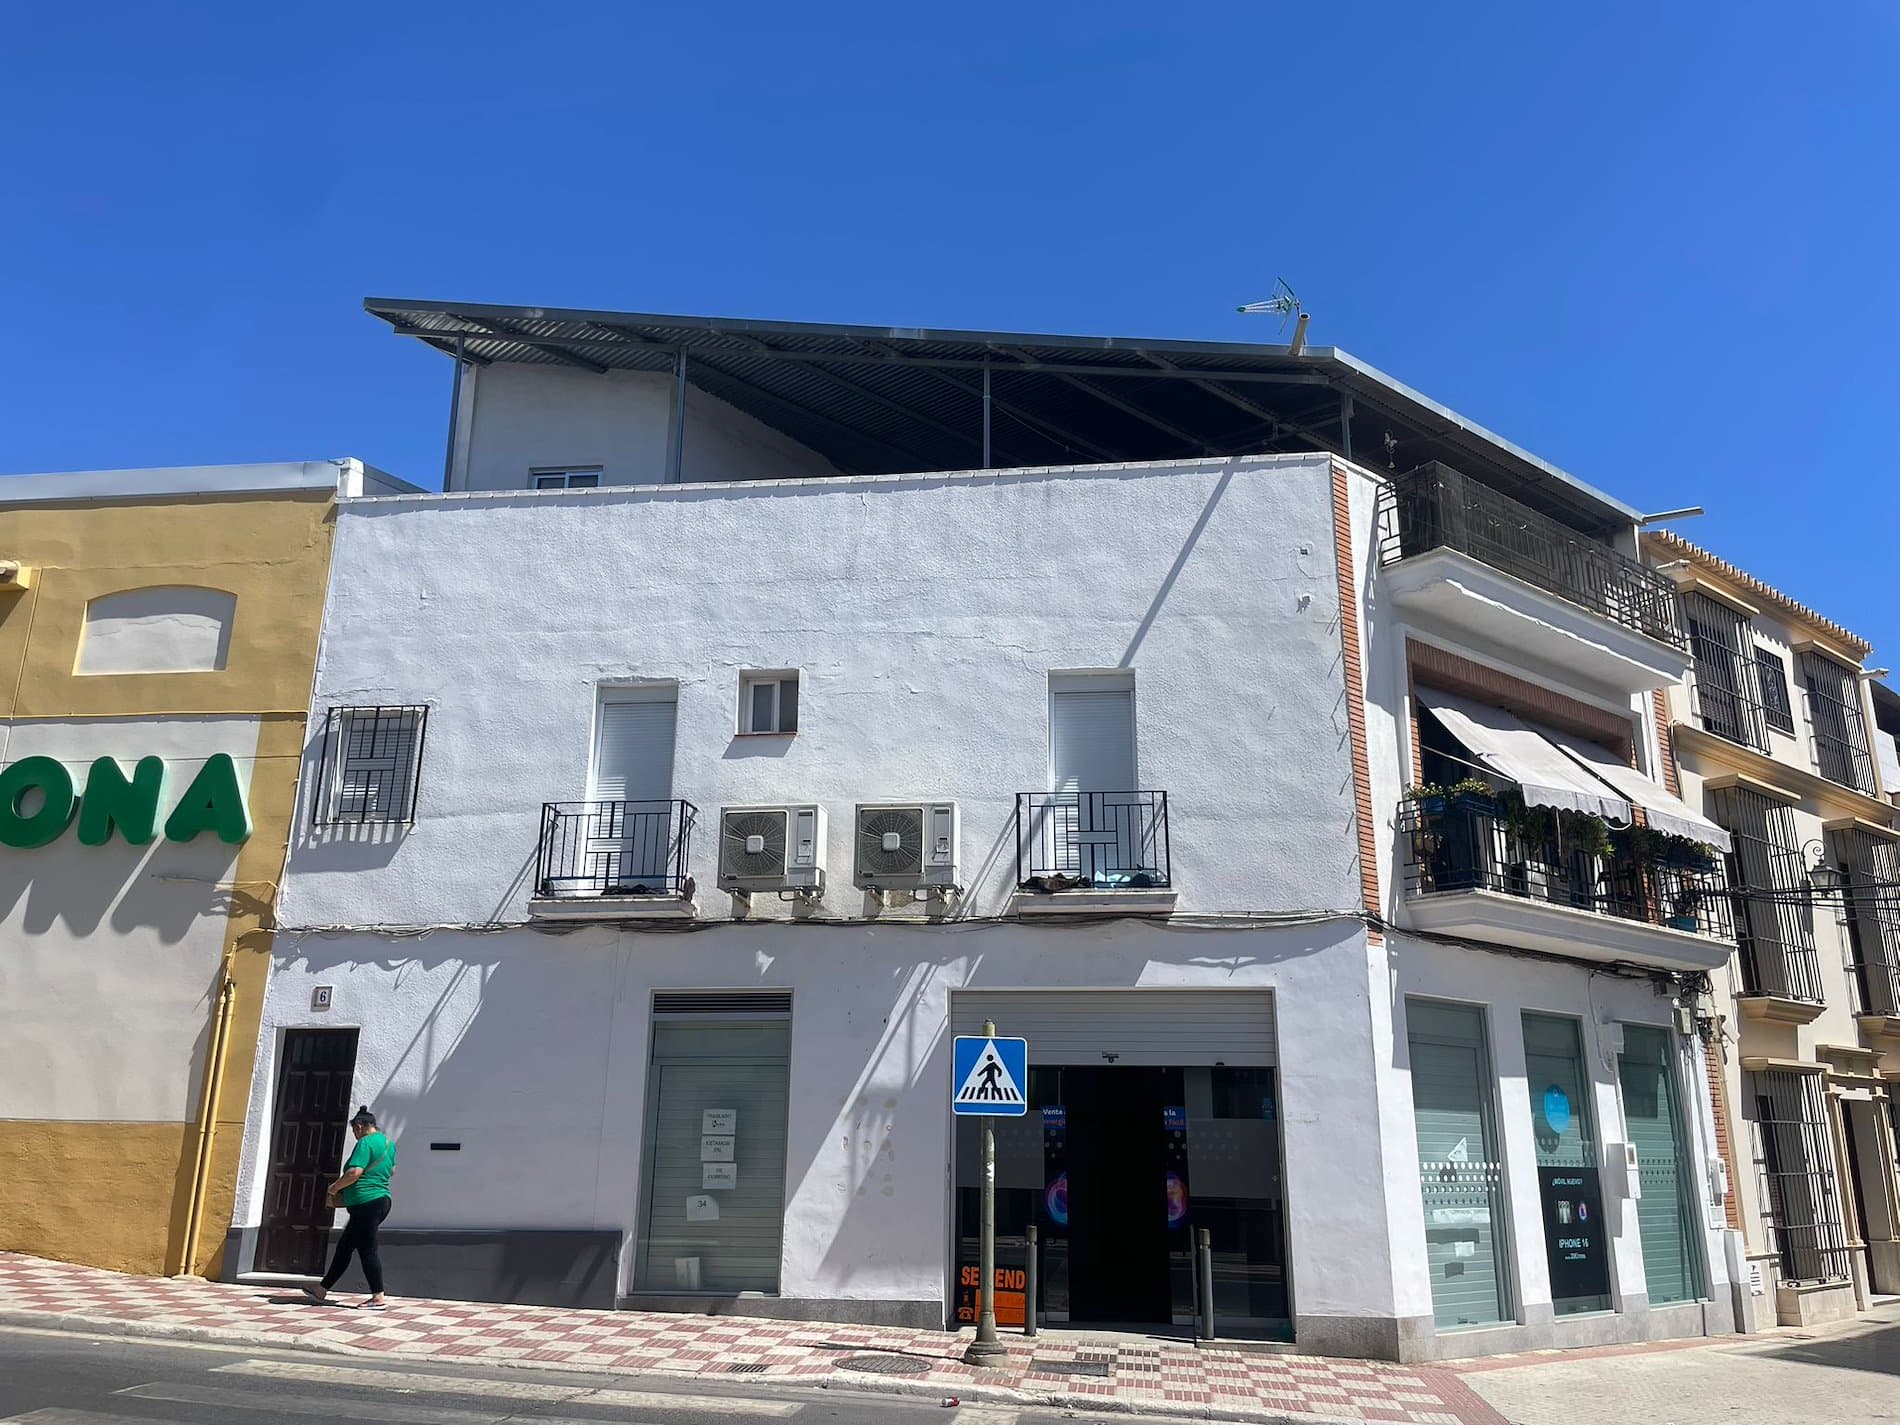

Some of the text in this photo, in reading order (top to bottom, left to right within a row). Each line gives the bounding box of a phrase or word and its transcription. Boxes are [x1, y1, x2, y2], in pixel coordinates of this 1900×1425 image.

[0, 753, 253, 849] ONA
[320, 991, 327, 1003] 6
[1559, 1238, 1581, 1249] IPHONE
[961, 1266, 1026, 1289] SE END
